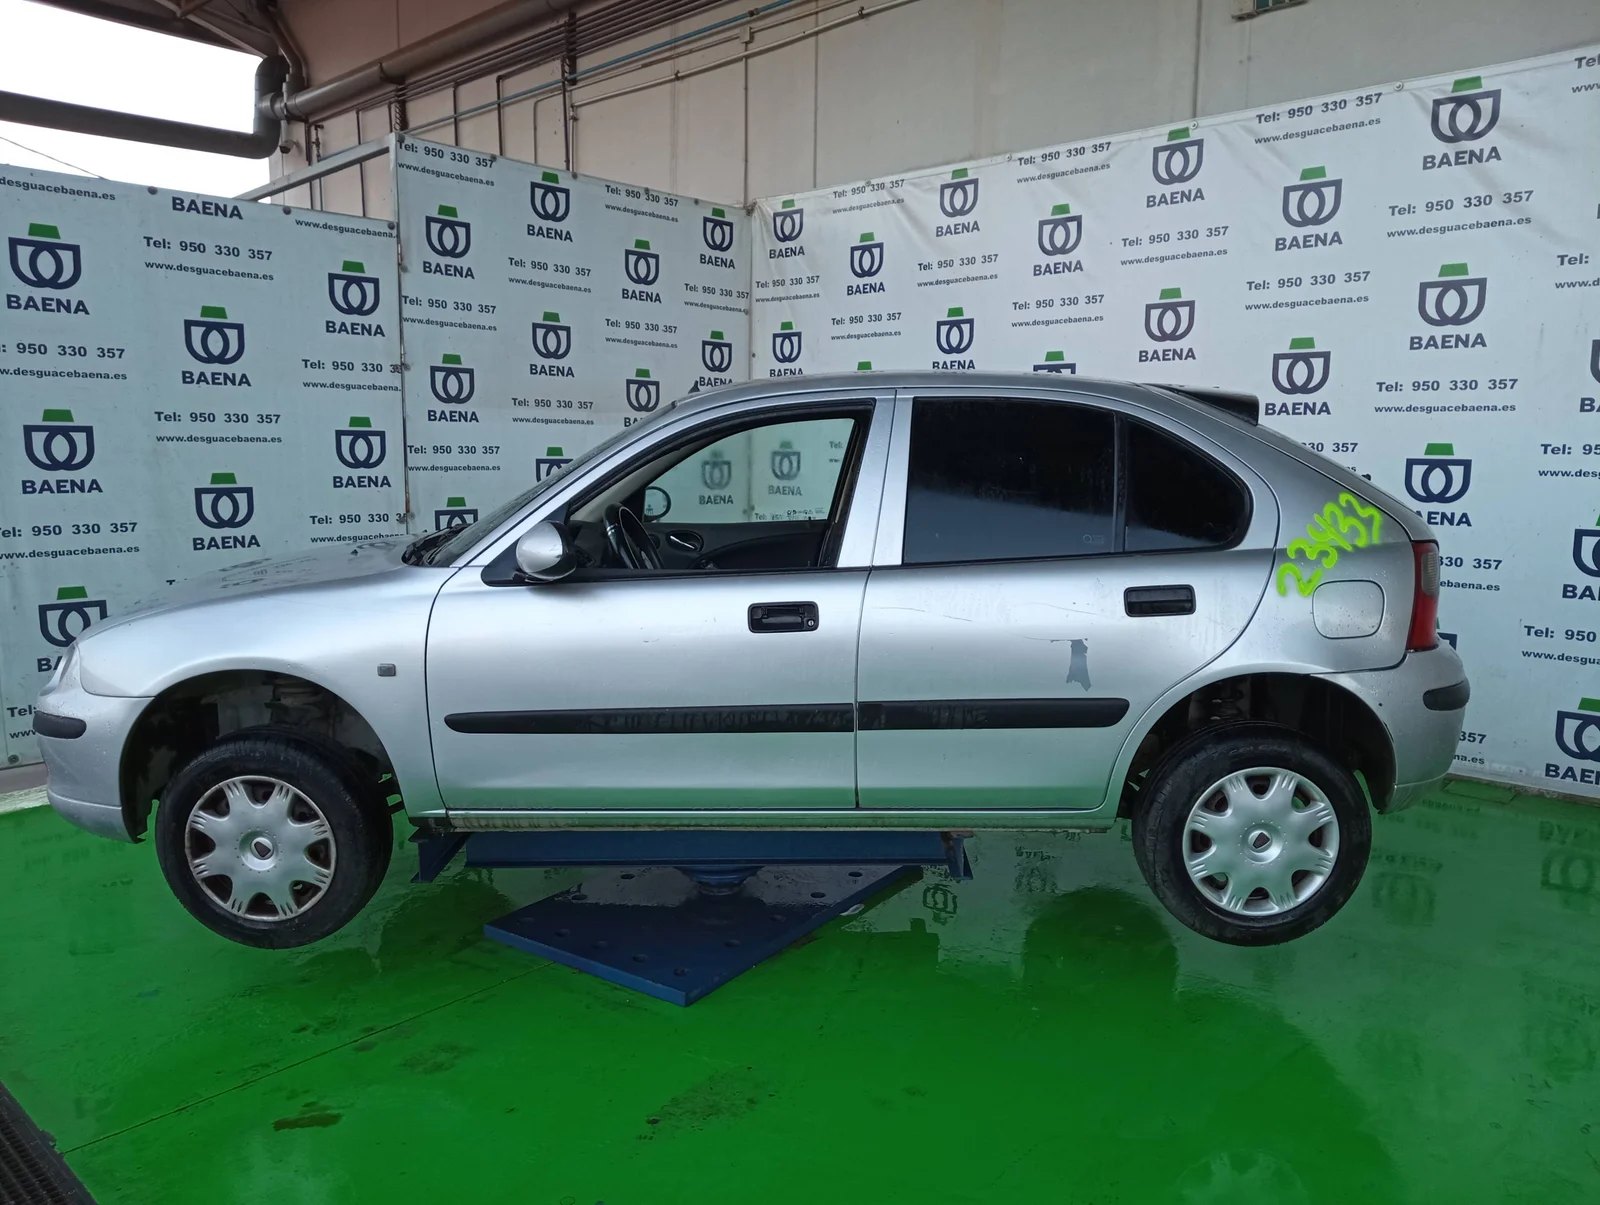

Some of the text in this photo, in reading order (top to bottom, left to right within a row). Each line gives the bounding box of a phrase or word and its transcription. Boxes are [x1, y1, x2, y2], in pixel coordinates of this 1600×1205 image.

[1256, 92, 1383, 124] Tel: 950 330 357
[1254, 116, 1381, 145] www.desguacebaena.es
[398, 140, 494, 168] Tel: 950 330 357
[1017, 141, 1112, 166] Tel: 950 330 357
[1422, 146, 1502, 170] BAENA
[398, 161, 495, 187] www.desguacebaena.es
[1017, 162, 1110, 183] www.desguacebaena.es
[605, 184, 679, 207] Tel: 950 330 357
[833, 178, 905, 199] Tel: 950 330 357
[1146, 188, 1205, 208] BAENA
[1388, 190, 1534, 216] Tel: 950 330 357
[172, 196, 243, 220] BAENA
[527, 224, 573, 242] BAENA
[936, 220, 980, 237] BAENA
[1387, 217, 1532, 238] www.desguacebaena.es
[1121, 226, 1229, 247] Tel: 950 330 357
[1275, 231, 1343, 251] BAENA
[143, 236, 272, 260] Tel: 950 330 357
[769, 245, 805, 259] BAENA
[700, 253, 735, 269] BAENA
[918, 254, 999, 271] Tel: 950 330 357
[1120, 249, 1228, 266] www.desguacebaena.es
[1557, 253, 1589, 266] Tel:
[144, 262, 274, 281] www.desguacebaena.es
[423, 261, 475, 279] BAENA
[508, 257, 591, 277] Tel: 950 330 357
[1033, 260, 1084, 277] BAENA
[508, 277, 591, 293] www.desguacebaena.es
[772, 279, 786, 287] 950
[789, 277, 803, 286] 330
[806, 275, 820, 284] 357
[917, 273, 998, 287] www.desguacebaena.es
[1246, 271, 1371, 291] Tel: 950 330 357
[622, 288, 662, 304] BAENA
[684, 283, 749, 299] Tel: 950 330 357
[847, 282, 885, 296] BAENA
[6, 294, 90, 315] BAENA
[402, 295, 496, 314] Tel: 950 330 357
[1012, 294, 1104, 310] Tel: 950 330 357
[1245, 296, 1369, 310] www.desguacebaena.es
[402, 316, 497, 332] www.desguacebaena.es
[605, 318, 677, 334] Tel: 950 330 357
[831, 312, 902, 326] Tel: 950 330 357
[1011, 315, 1104, 328] www.desguacebaena.es
[325, 320, 385, 337] BAENA
[605, 336, 678, 349] www.desguacebaena.es
[1409, 333, 1487, 350] BAENA
[16, 342, 47, 355] 950
[57, 345, 87, 357] 330
[97, 347, 125, 359] 357
[1139, 347, 1196, 363] BAENA
[301, 359, 325, 369] Tel:
[332, 361, 354, 371] 950
[361, 362, 383, 373] 330
[530, 364, 575, 378] BAENA
[181, 370, 252, 387] BAENA
[1376, 378, 1518, 392] Tel: 950 330 357
[511, 397, 593, 410] Tel: 950 330 357
[1264, 401, 1331, 416] BAENA
[1375, 403, 1516, 414] www.desguacebaena.es
[154, 411, 281, 424] Tel: 950 330 357
[428, 409, 479, 423] BAENA
[512, 416, 594, 426] www.desguacebaena.es
[156, 434, 282, 444] www.desguacebaena.es
[1332, 442, 1358, 452] 357
[407, 445, 500, 454] Tel: 950 330 357
[1540, 444, 1572, 455] Tel:
[408, 464, 500, 473] www.desguacebaena.es
[21, 479, 103, 495] BAENA
[333, 475, 392, 488] BAENA
[768, 485, 802, 496] BAENA
[699, 495, 734, 505] BAENA
[309, 515, 332, 525] Tel:
[339, 514, 361, 524] 950
[368, 513, 389, 523] 330
[32, 522, 138, 536] 950 330 357
[192, 535, 261, 551] BAENA
[1473, 558, 1502, 570] 357
[1524, 625, 1597, 642] Tel: 950
